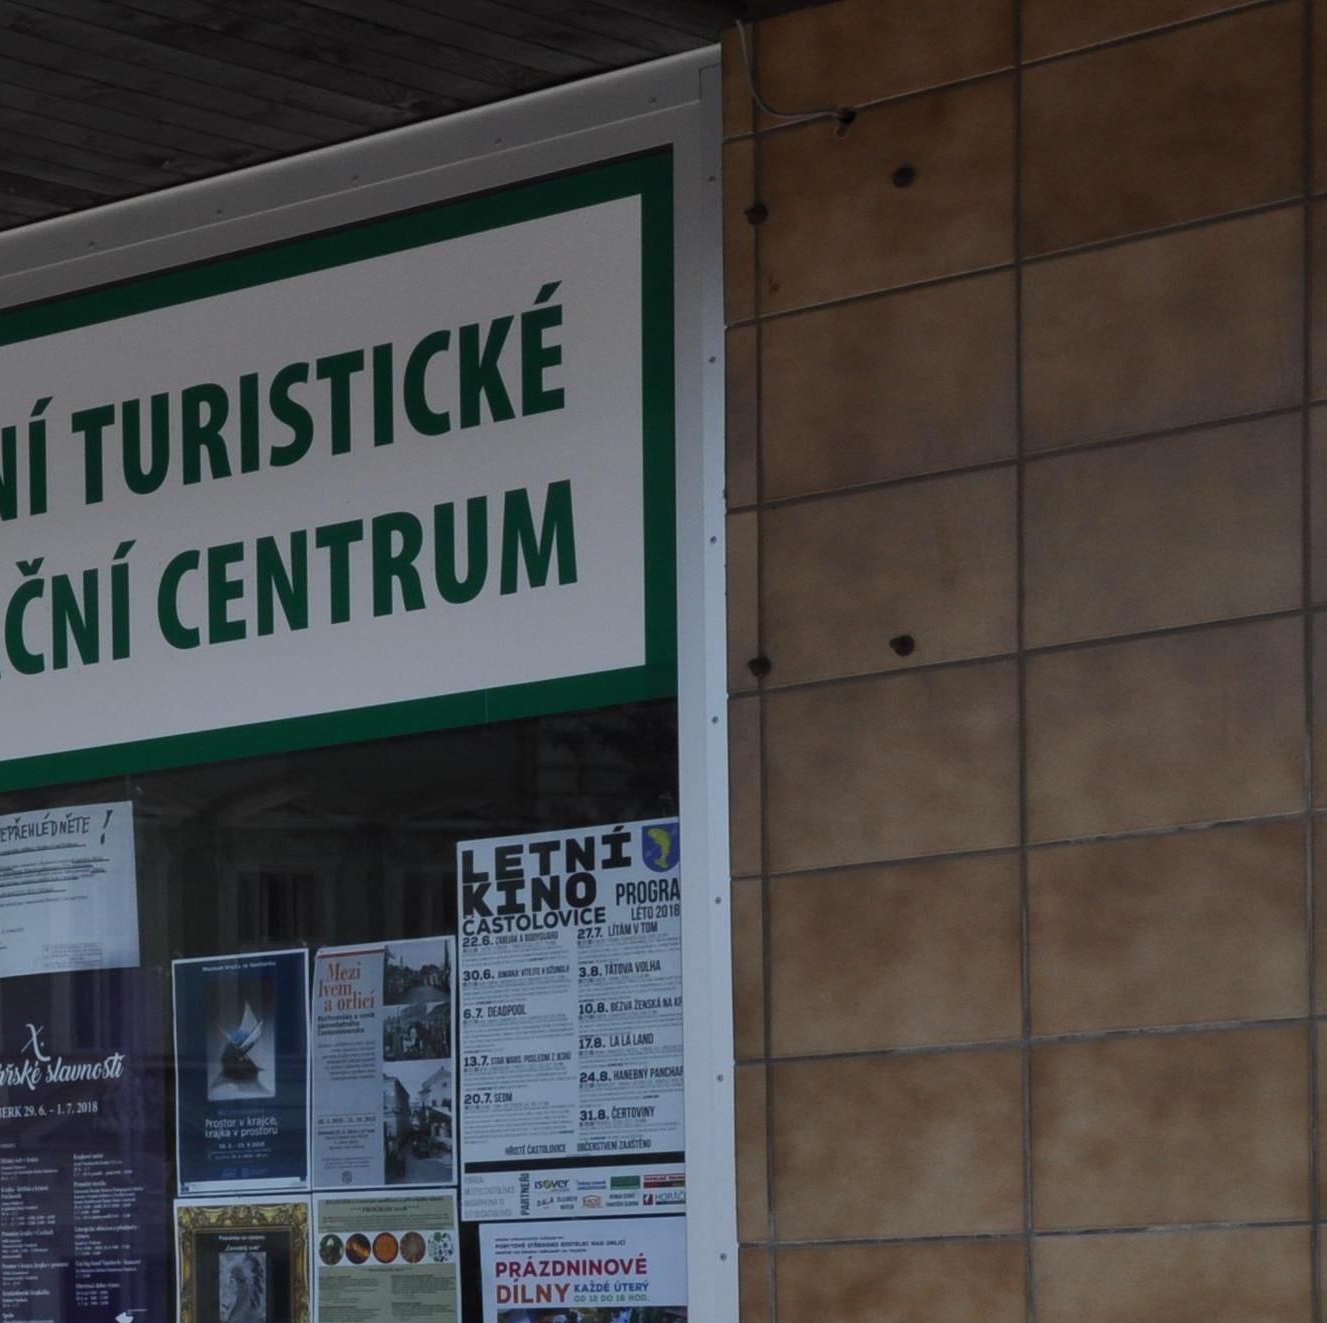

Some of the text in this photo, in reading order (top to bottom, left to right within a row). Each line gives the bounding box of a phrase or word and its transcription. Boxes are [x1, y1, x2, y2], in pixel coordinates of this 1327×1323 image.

[73, 281, 566, 506] TURISTICKÉ
[157, 479, 578, 652] CENTRUM
[100, 808, 113, 845] !
[461, 826, 631, 883] LETNÍ
[463, 872, 597, 920] KINO
[656, 903, 680, 919] 2018
[577, 928, 603, 940] 27.7.
[462, 937, 494, 948] 22.6.
[329, 961, 361, 980] Mezi
[462, 969, 495, 982] 30.6.
[578, 959, 661, 978] 3.8. TÁTOVA VOLHA
[318, 979, 352, 997] lvem
[337, 990, 376, 1011] orlicí
[463, 1003, 527, 1019] 6.7. DEADPOOL
[578, 1003, 609, 1015] 10.8.
[578, 1033, 654, 1049] 17.8. LA LA LAND
[46, 1052, 125, 1085] slavnosti
[463, 1055, 490, 1067] 13.7.
[579, 1072, 612, 1083] 24.8.
[464, 1093, 492, 1104] 20.7.
[23, 1105, 38, 1118] 29.
[76, 1101, 99, 1115] 2018
[579, 1105, 655, 1121] 31.8. ČERTOVINY
[205, 1116, 237, 1129] Prostor
[205, 1125, 278, 1139] krajka prostoru
[495, 1253, 647, 1277] PRÁZDNINOVÉ
[497, 1279, 649, 1304] DÍLNY KAŽDÉ ÚTERÝ
